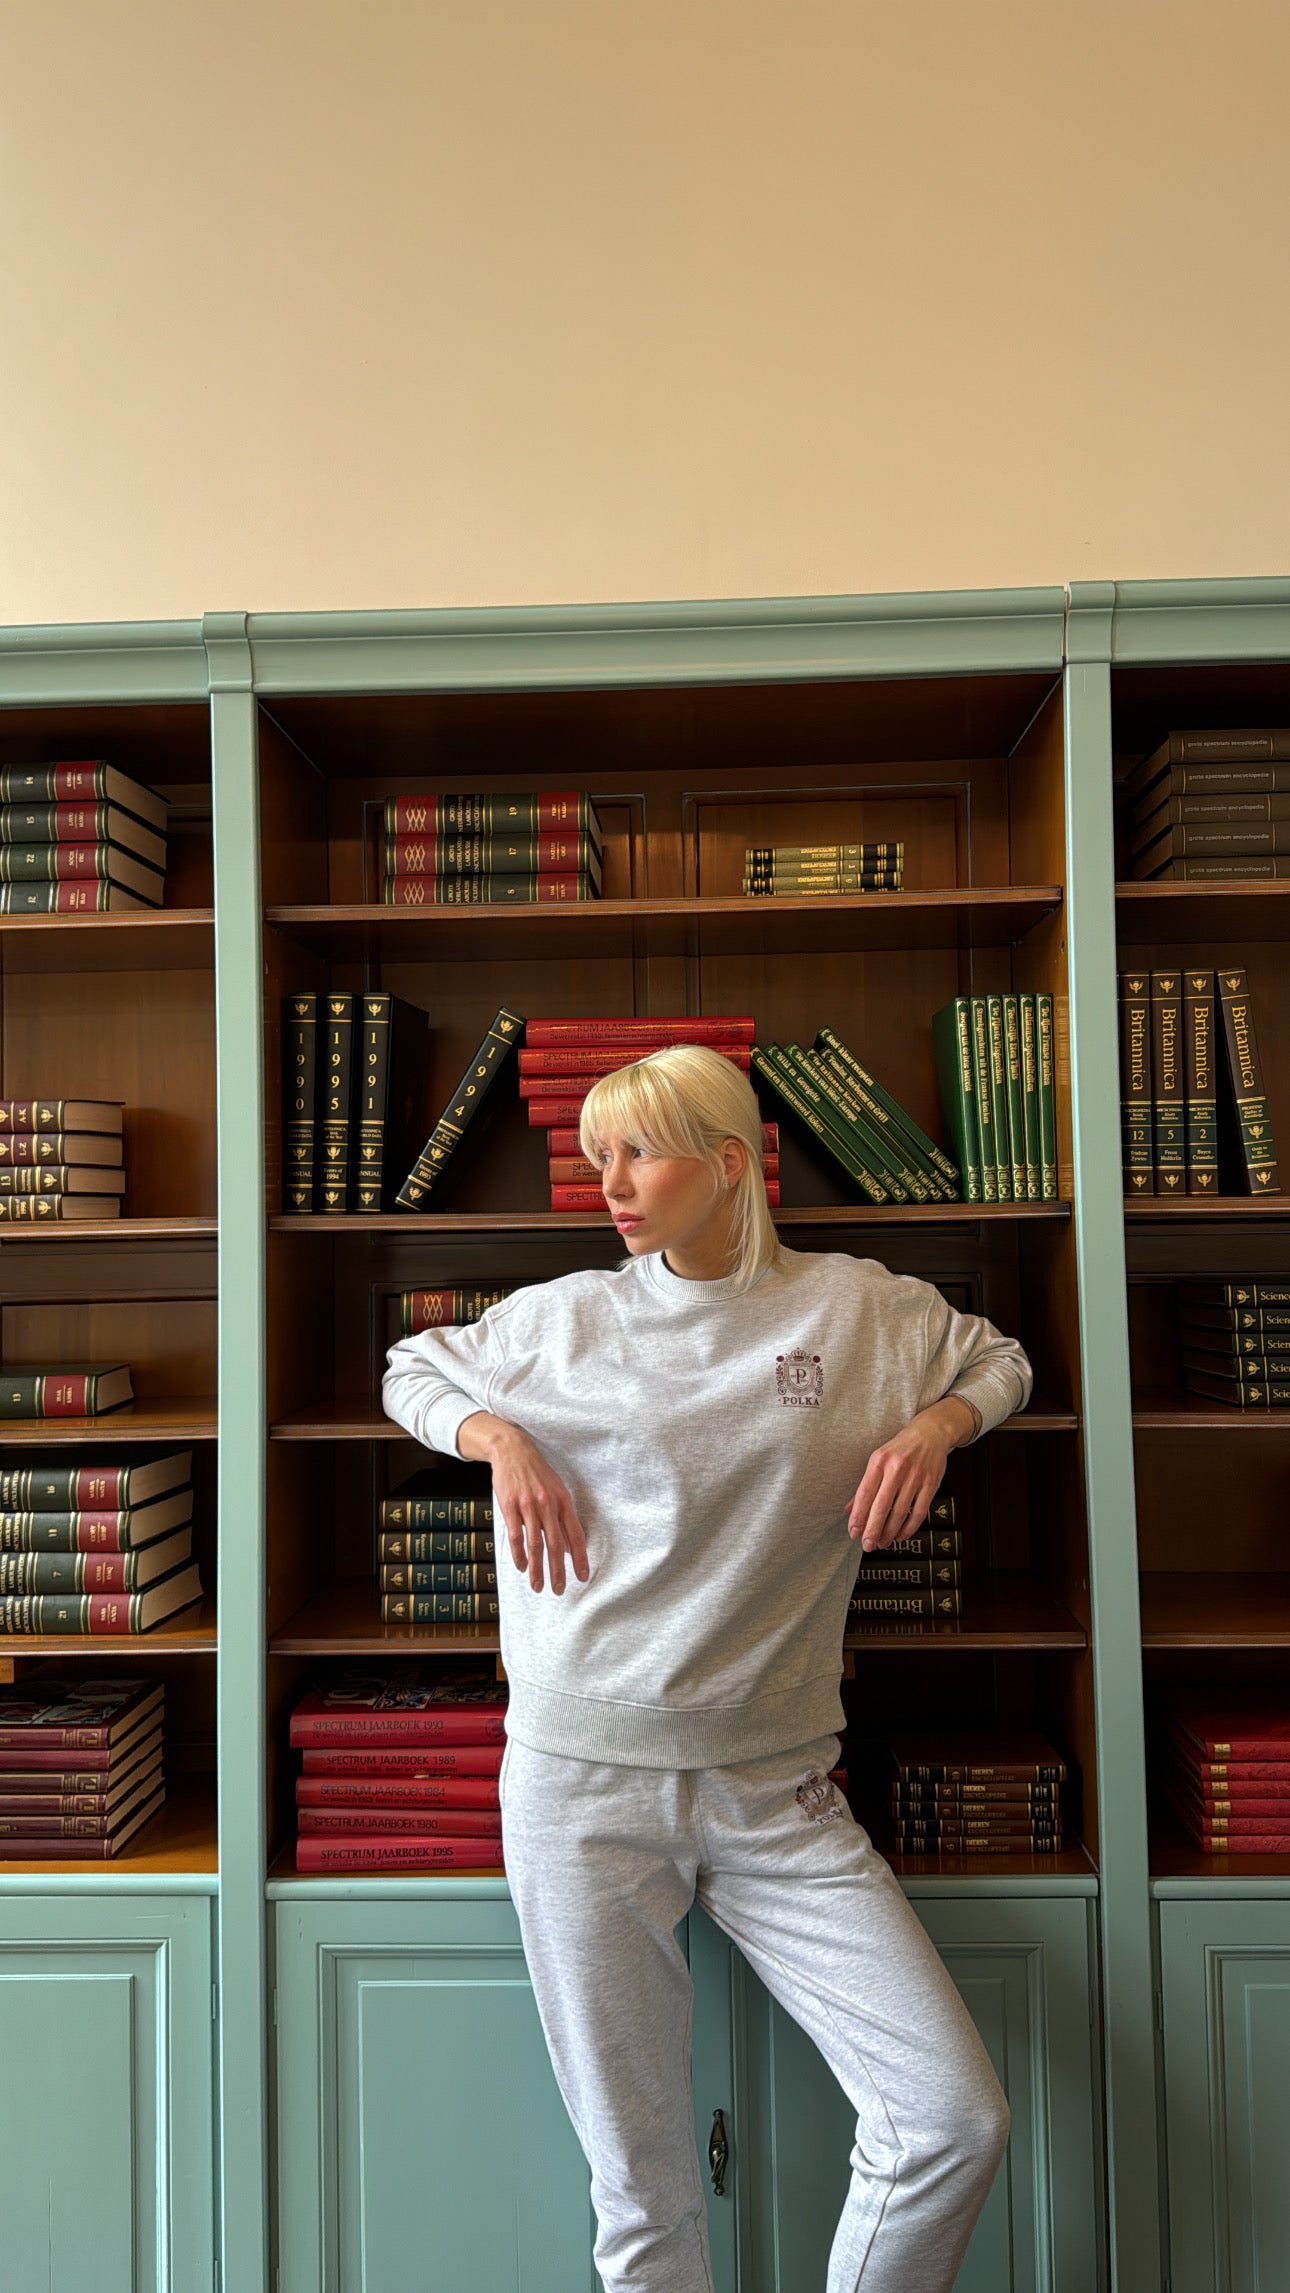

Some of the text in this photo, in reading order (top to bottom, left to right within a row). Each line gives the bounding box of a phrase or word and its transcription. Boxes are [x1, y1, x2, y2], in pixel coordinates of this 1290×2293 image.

[509, 807, 516, 816] 19
[27, 816, 34, 824] 15
[26, 854, 34, 863] 22
[993, 1006, 999, 1016] De
[1042, 1006, 1049, 1016] De
[550, 1023, 600, 1032] SPECTRUM
[976, 1008, 985, 1056] Streekgerechten
[1024, 1007, 1034, 1092] Italiaanse Specialiteiten
[1130, 1009, 1146, 1091] Britannica
[1162, 1008, 1178, 1090] Britannica
[1194, 1007, 1210, 1089] Britannica
[1232, 1005, 1255, 1089] Britannica
[543, 1052, 591, 1060] SPECTRUM
[993, 1042, 1002, 1084] Visgerechten
[331, 1032, 341, 1110] 1995
[368, 1032, 377, 1110] 1991
[801, 1058, 821, 1081] Keuken
[818, 1078, 829, 1090] van
[851, 1061, 874, 1088] recepten
[455, 1047, 496, 1117] 1994
[775, 1051, 821, 1104] Wild en Gevogelte
[756, 1056, 825, 1133] Gezond en Verantwoord Koken
[842, 1091, 862, 1113] Keuken
[845, 1076, 870, 1103] Barbecue
[866, 1100, 875, 1110] en
[873, 1106, 889, 1124] Grill
[1133, 1130, 1144, 1140] 12
[1167, 1130, 1174, 1140] 5
[1200, 1129, 1206, 1139] 2
[1, 1176, 11, 1186] 13
[1271, 1363, 1290, 1372] Scie
[796, 1369, 806, 1384] P
[12, 1393, 21, 1402] 13
[783, 1397, 819, 1405] POLKA
[47, 1486, 55, 1494] 16
[436, 1511, 445, 1519] 9
[49, 1529, 57, 1537] 11
[436, 1544, 446, 1552] 7
[857, 1569, 921, 1583] Britann
[440, 1605, 449, 1613] 3
[59, 1611, 67, 1619] 21
[369, 1721, 420, 1731] JAARBOEK
[424, 1721, 443, 1729] 1993
[327, 1755, 455, 1765] SPECTRUM JAARBOEK 1989
[320, 1785, 445, 1797] SPECTRUM JAARBOEK 1984
[812, 1787, 825, 1804] P
[314, 1818, 438, 1829] SPECTRUM JAARBOEK 1980
[321, 1847, 453, 1859] SPECTRUM JAARBOEK 1995
